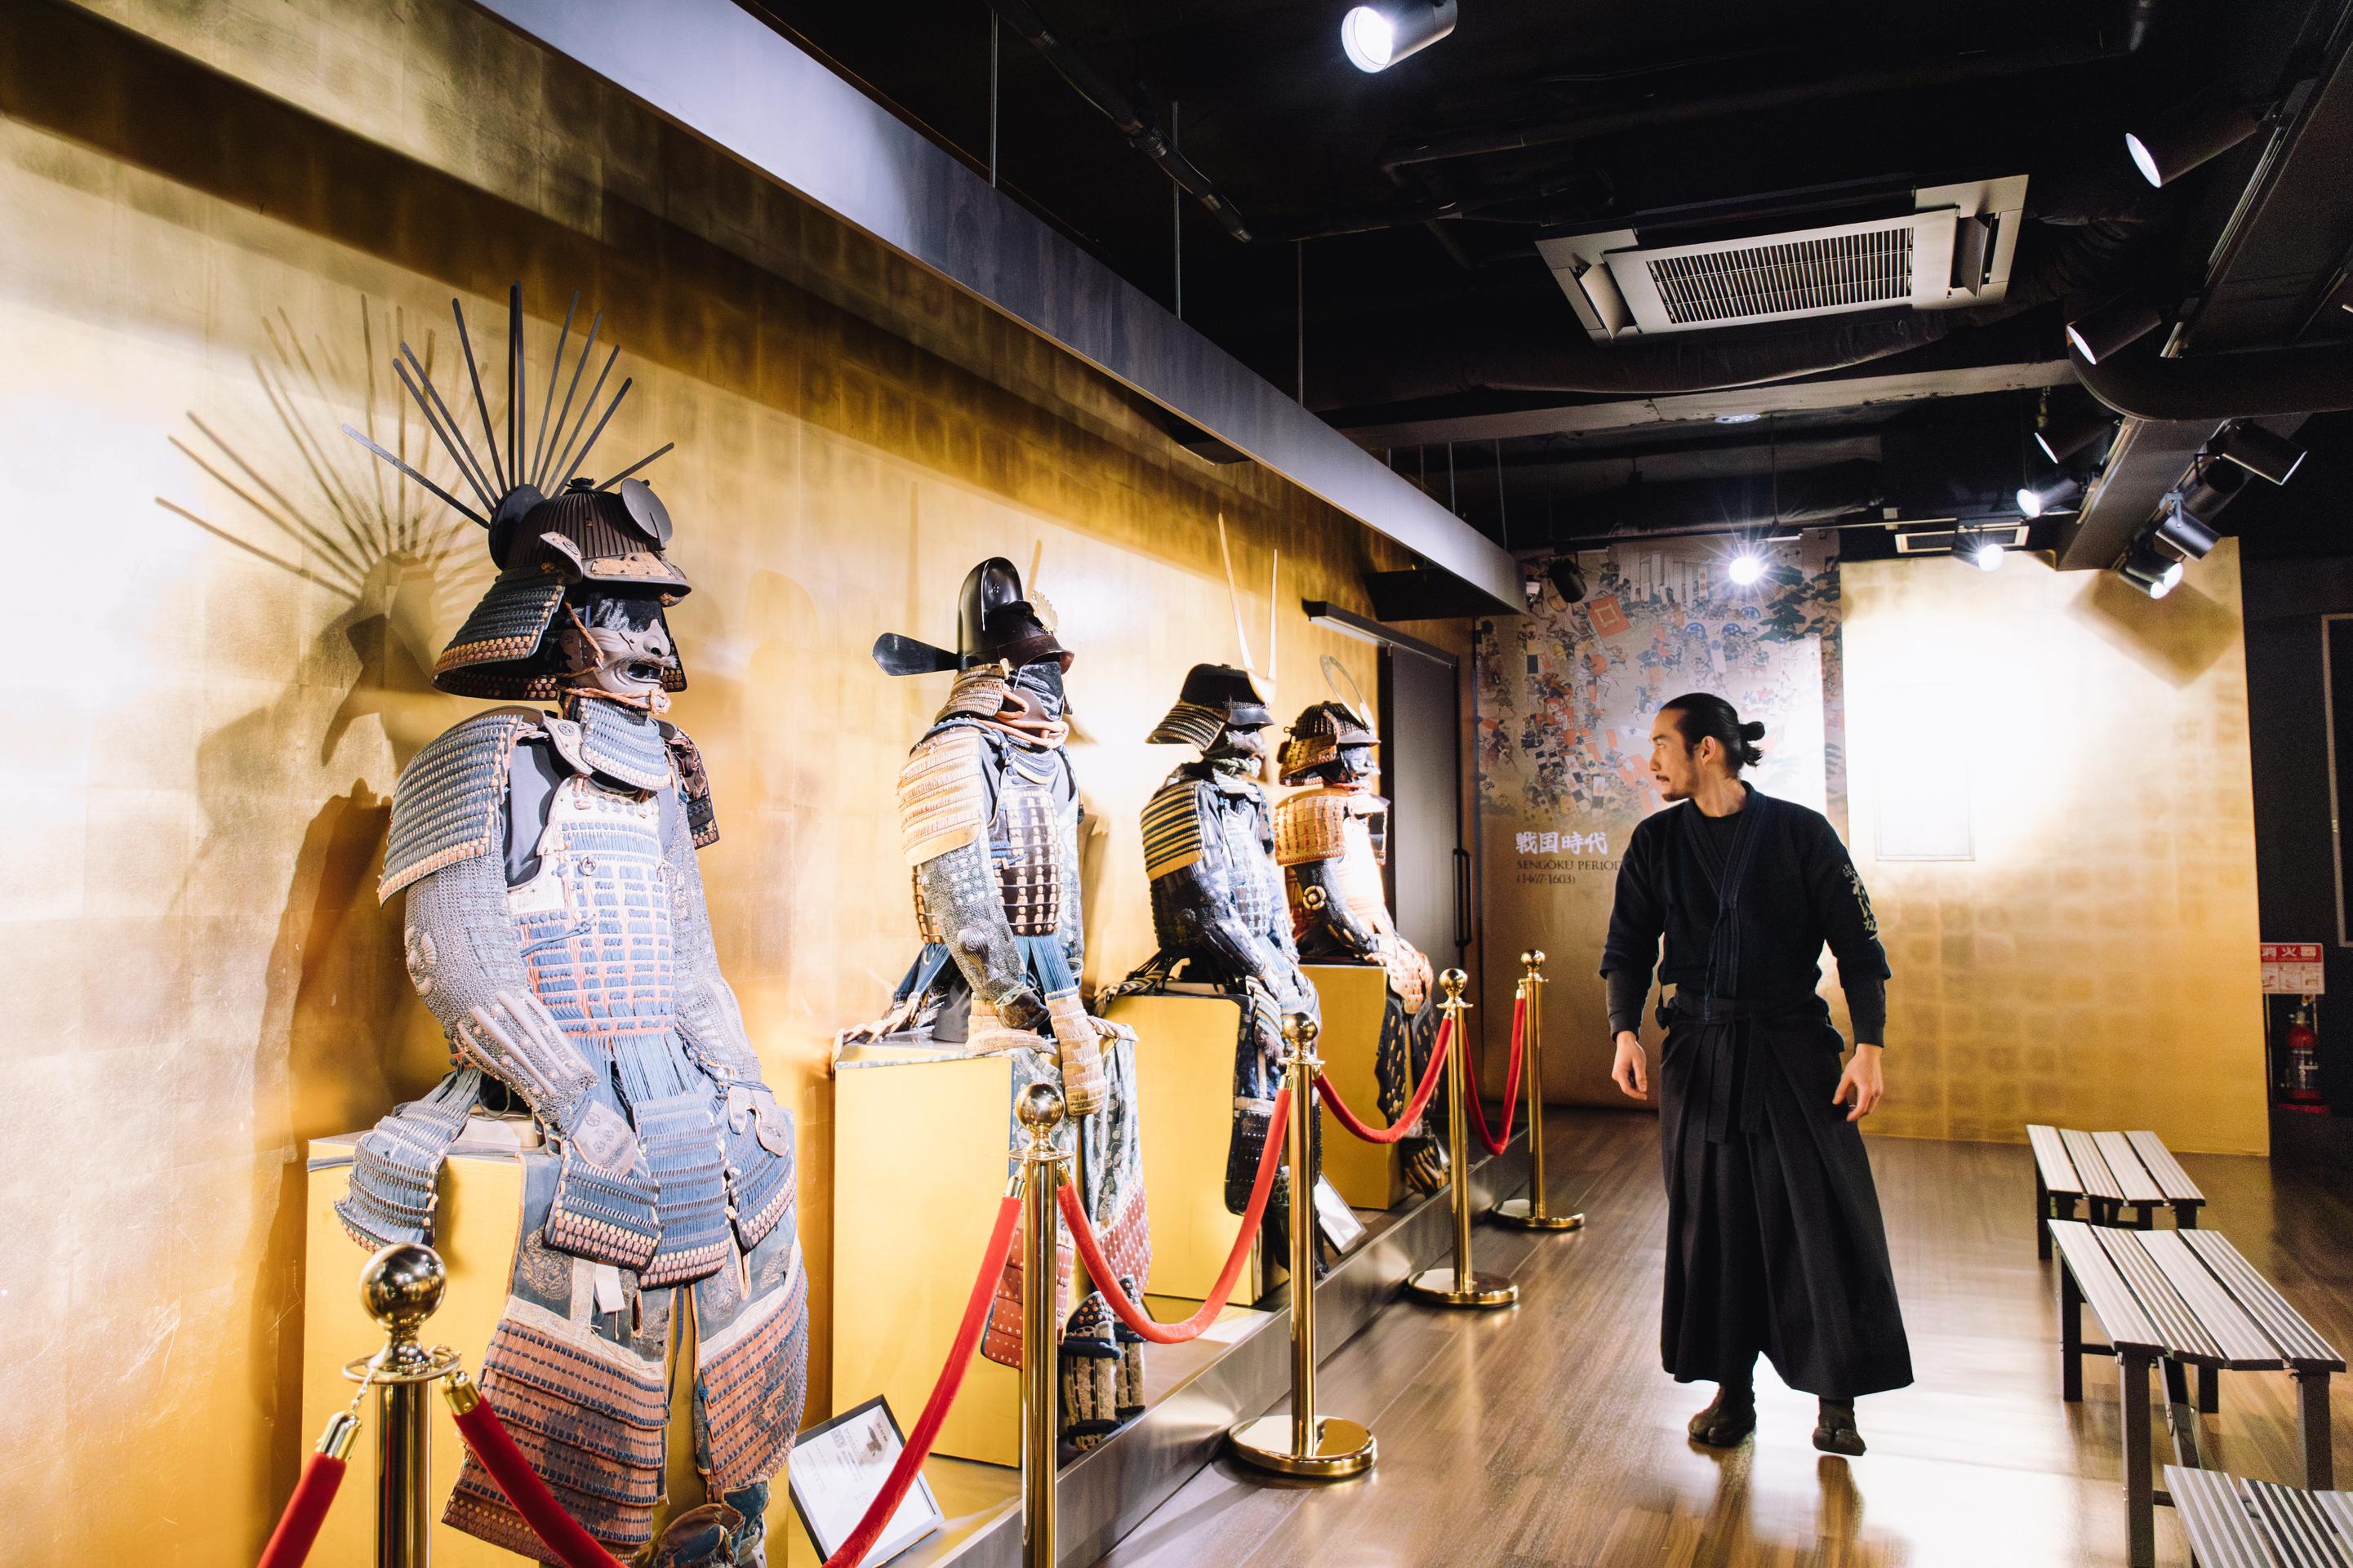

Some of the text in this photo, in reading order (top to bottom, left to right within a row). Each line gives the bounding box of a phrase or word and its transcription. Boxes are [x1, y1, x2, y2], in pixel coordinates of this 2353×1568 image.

[1515, 832, 1607, 855] 戦国時代
[1517, 860, 1573, 870] SENGOKU
